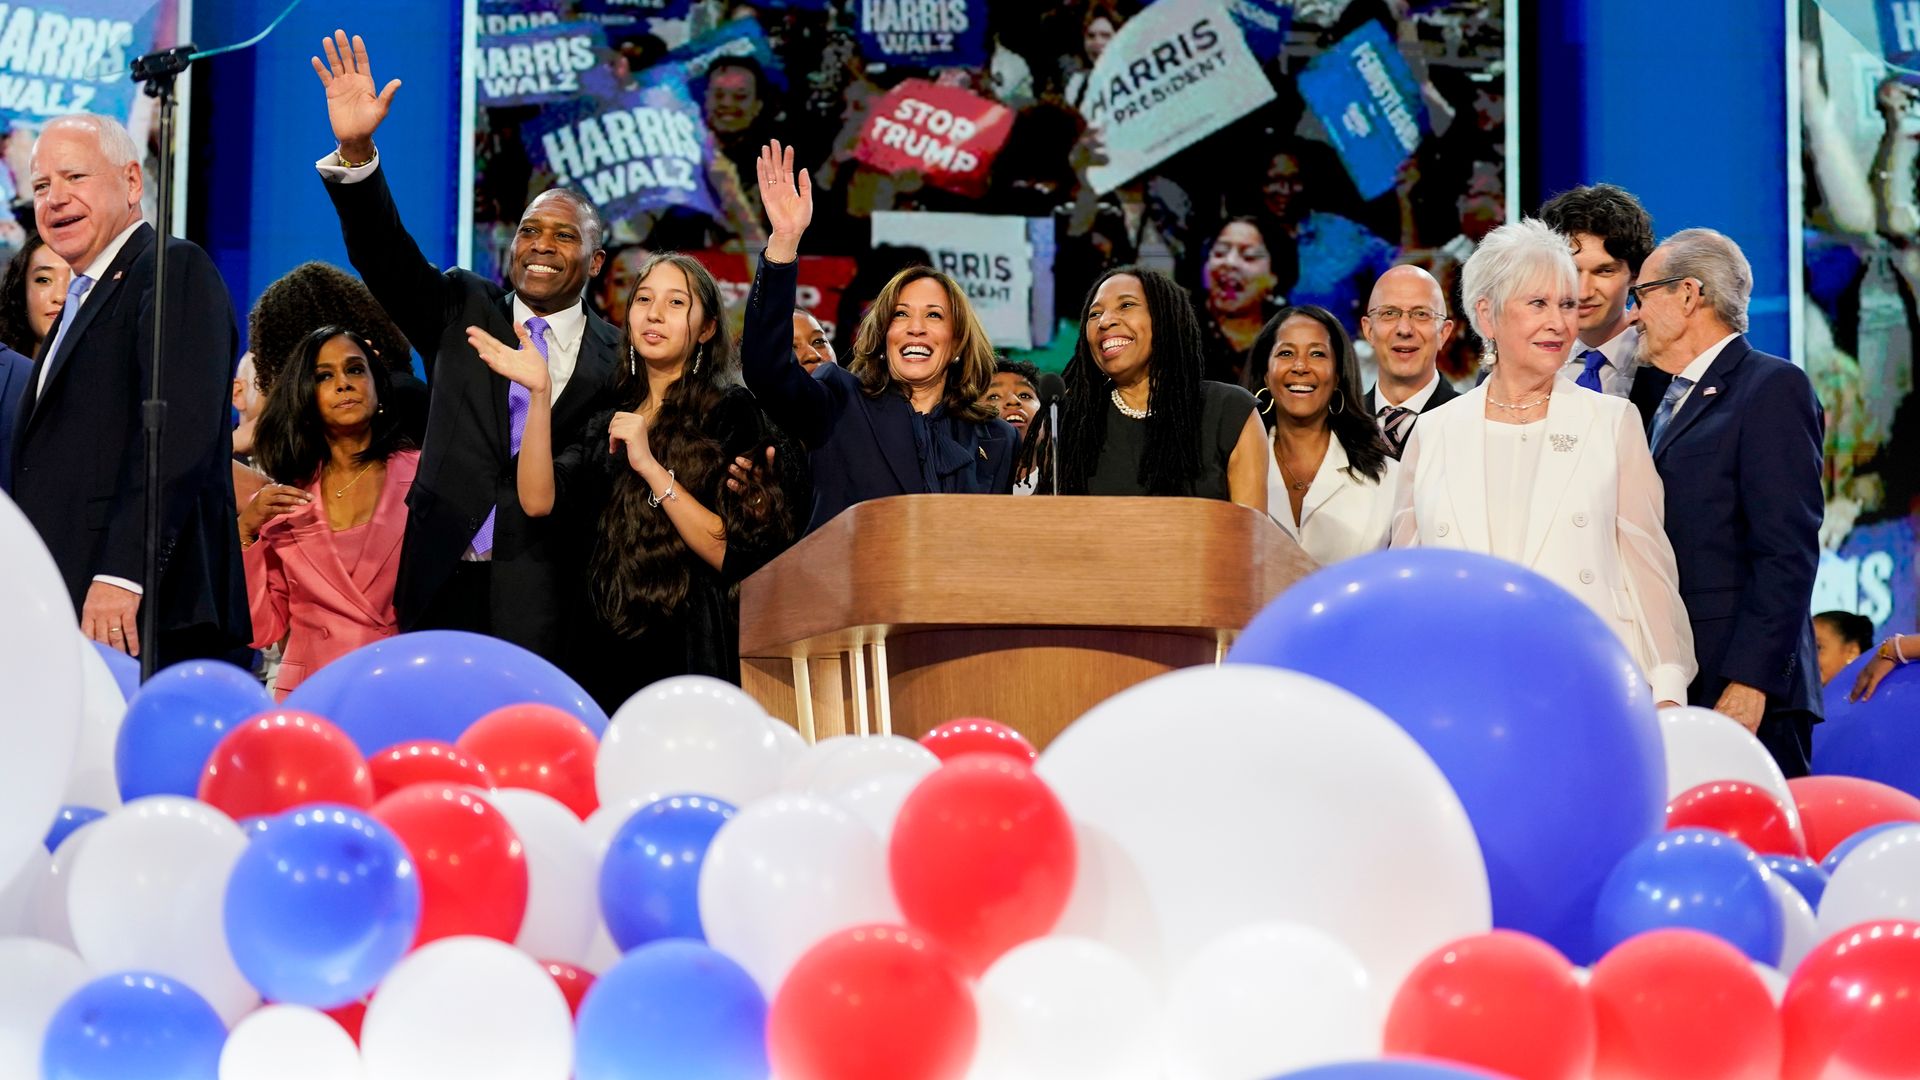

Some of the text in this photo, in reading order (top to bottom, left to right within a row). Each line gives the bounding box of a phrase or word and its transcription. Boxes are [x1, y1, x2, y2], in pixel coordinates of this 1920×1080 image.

[862, 0, 968, 33] HARRIS
[877, 32, 954, 54] WALZ
[482, 72, 579, 98] WALZ
[1092, 19, 1218, 120] HARRIS
[1114, 50, 1225, 124] PRESIDENT
[542, 106, 701, 179] HARRIS
[893, 98, 976, 143] STOP
[871, 116, 978, 173] TRUMP
[582, 157, 697, 206] WALZ
[938, 250, 1011, 282] RRIS
